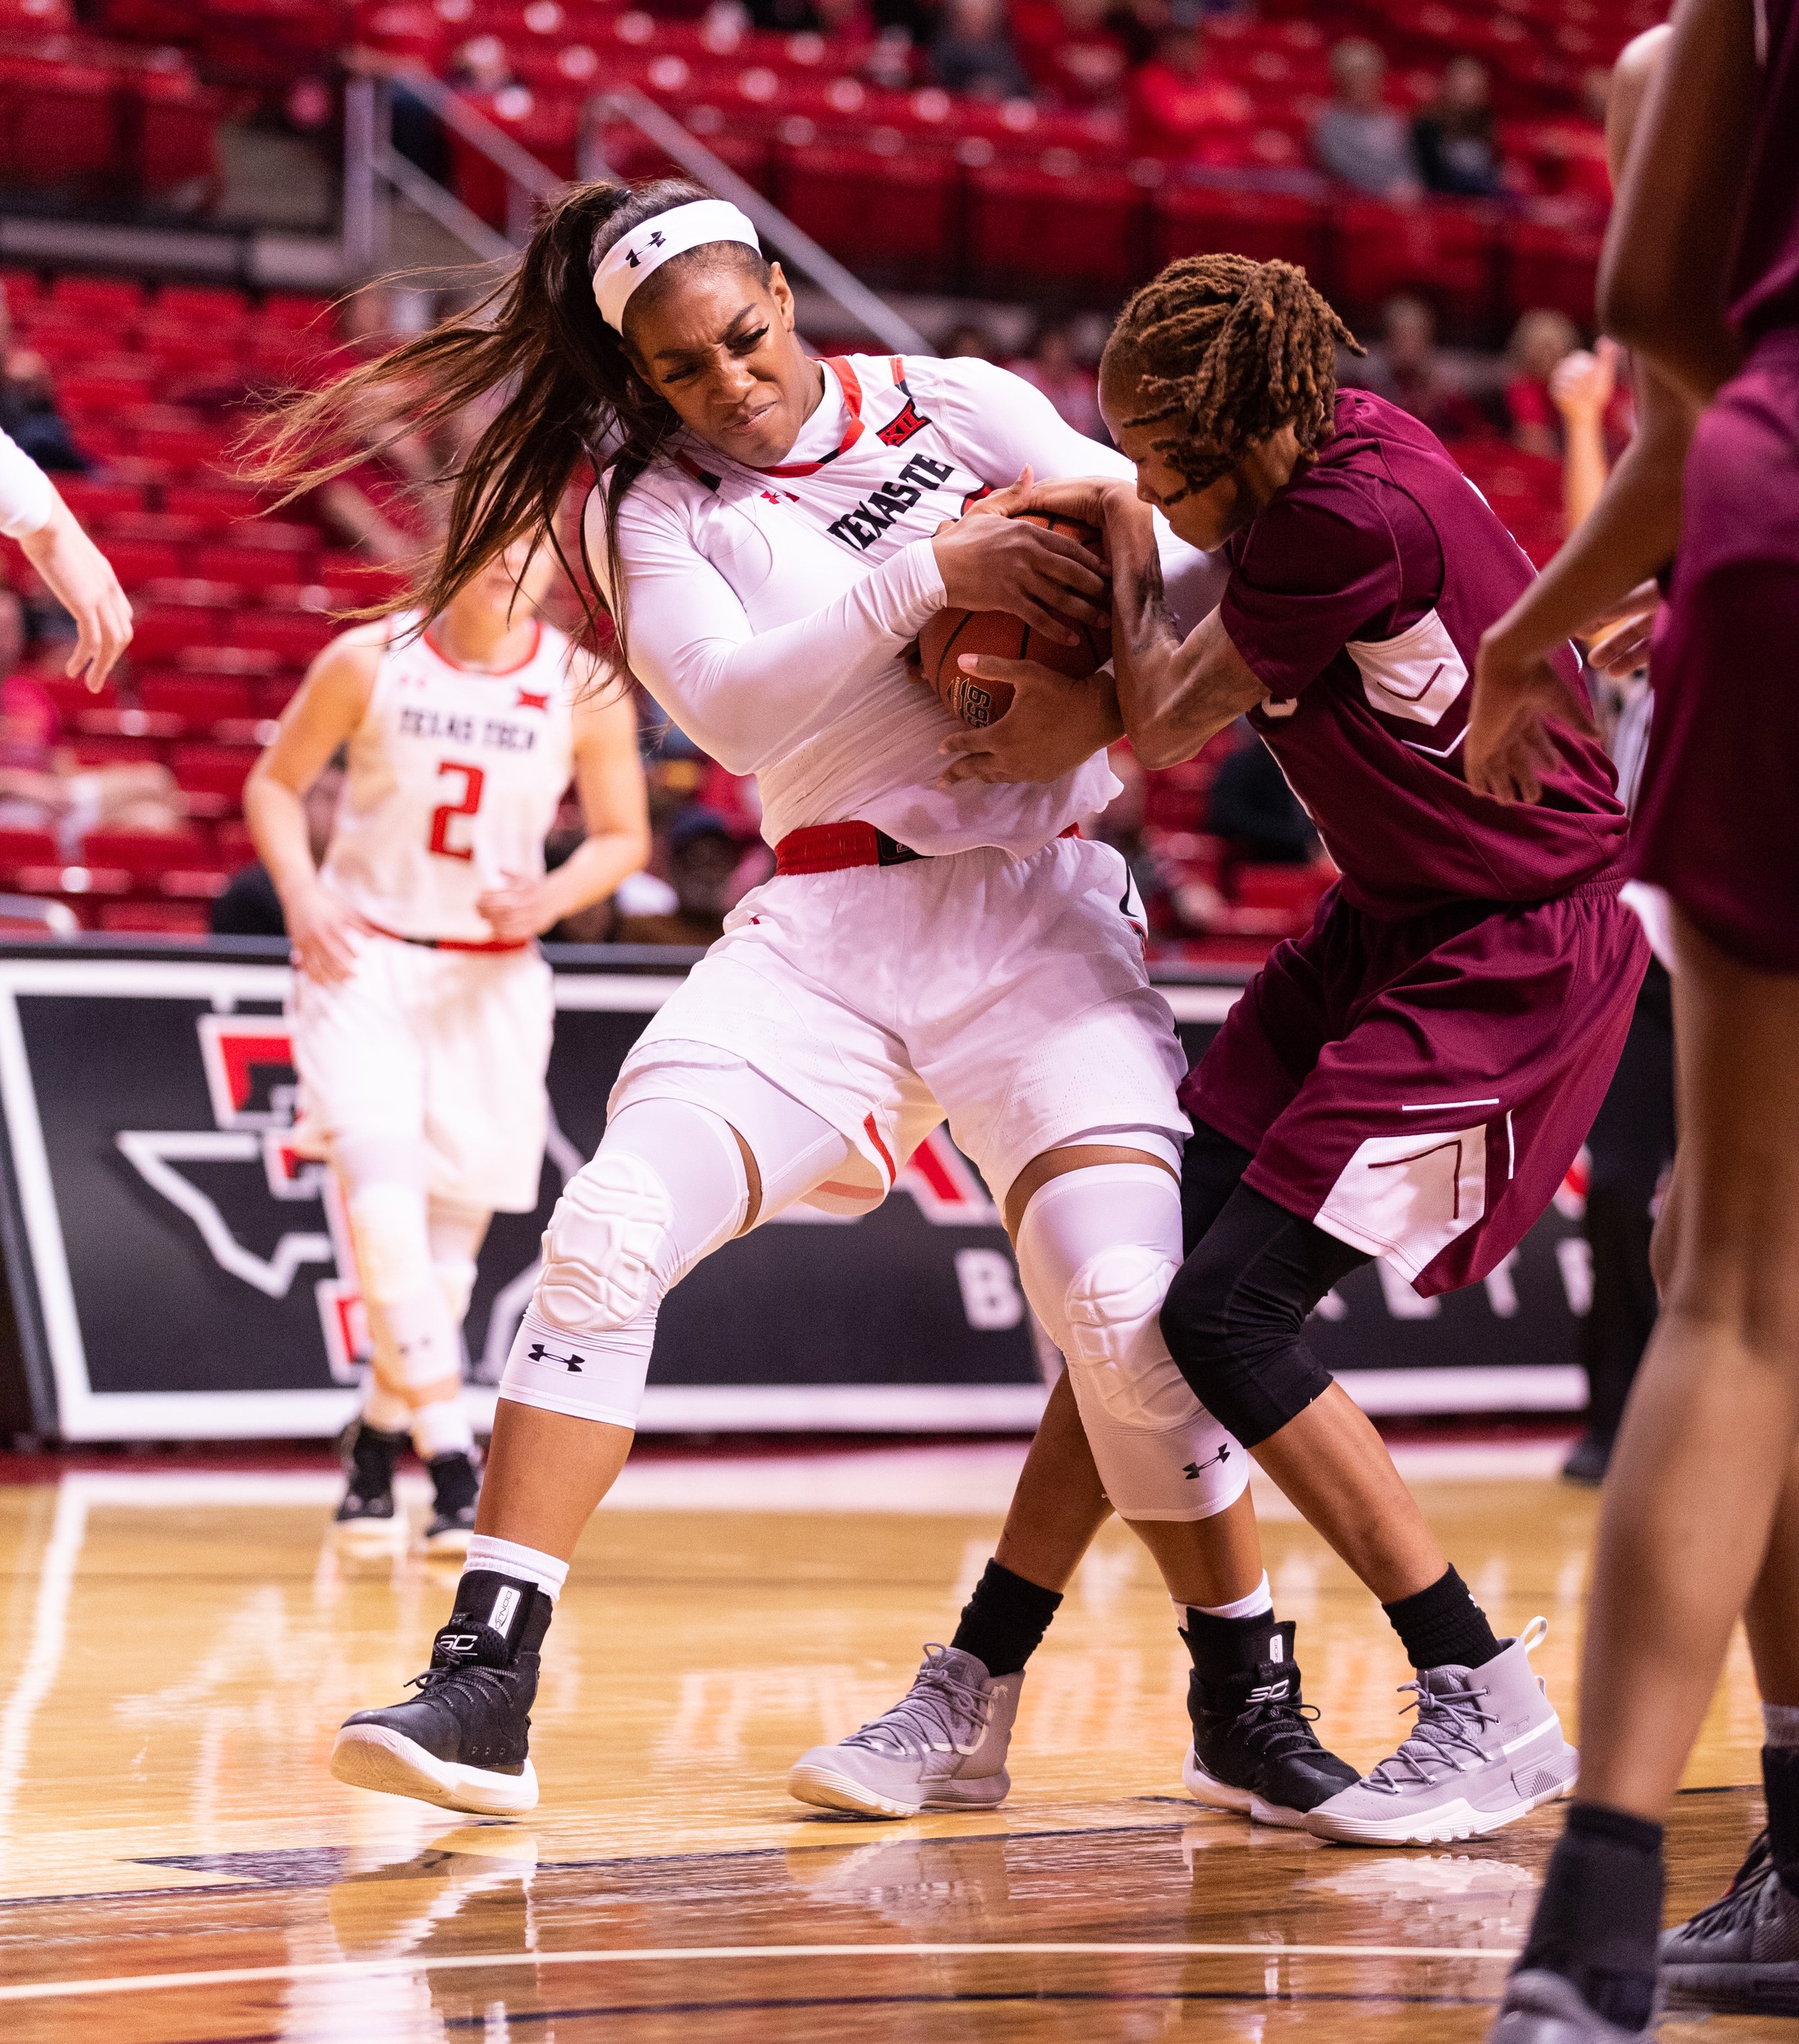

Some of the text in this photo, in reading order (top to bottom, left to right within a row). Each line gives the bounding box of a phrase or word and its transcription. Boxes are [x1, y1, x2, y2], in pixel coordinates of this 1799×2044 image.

[826, 481, 922, 552] TEXAS
[427, 761, 484, 861] 2
[495, 1590, 512, 1630] DONJO
